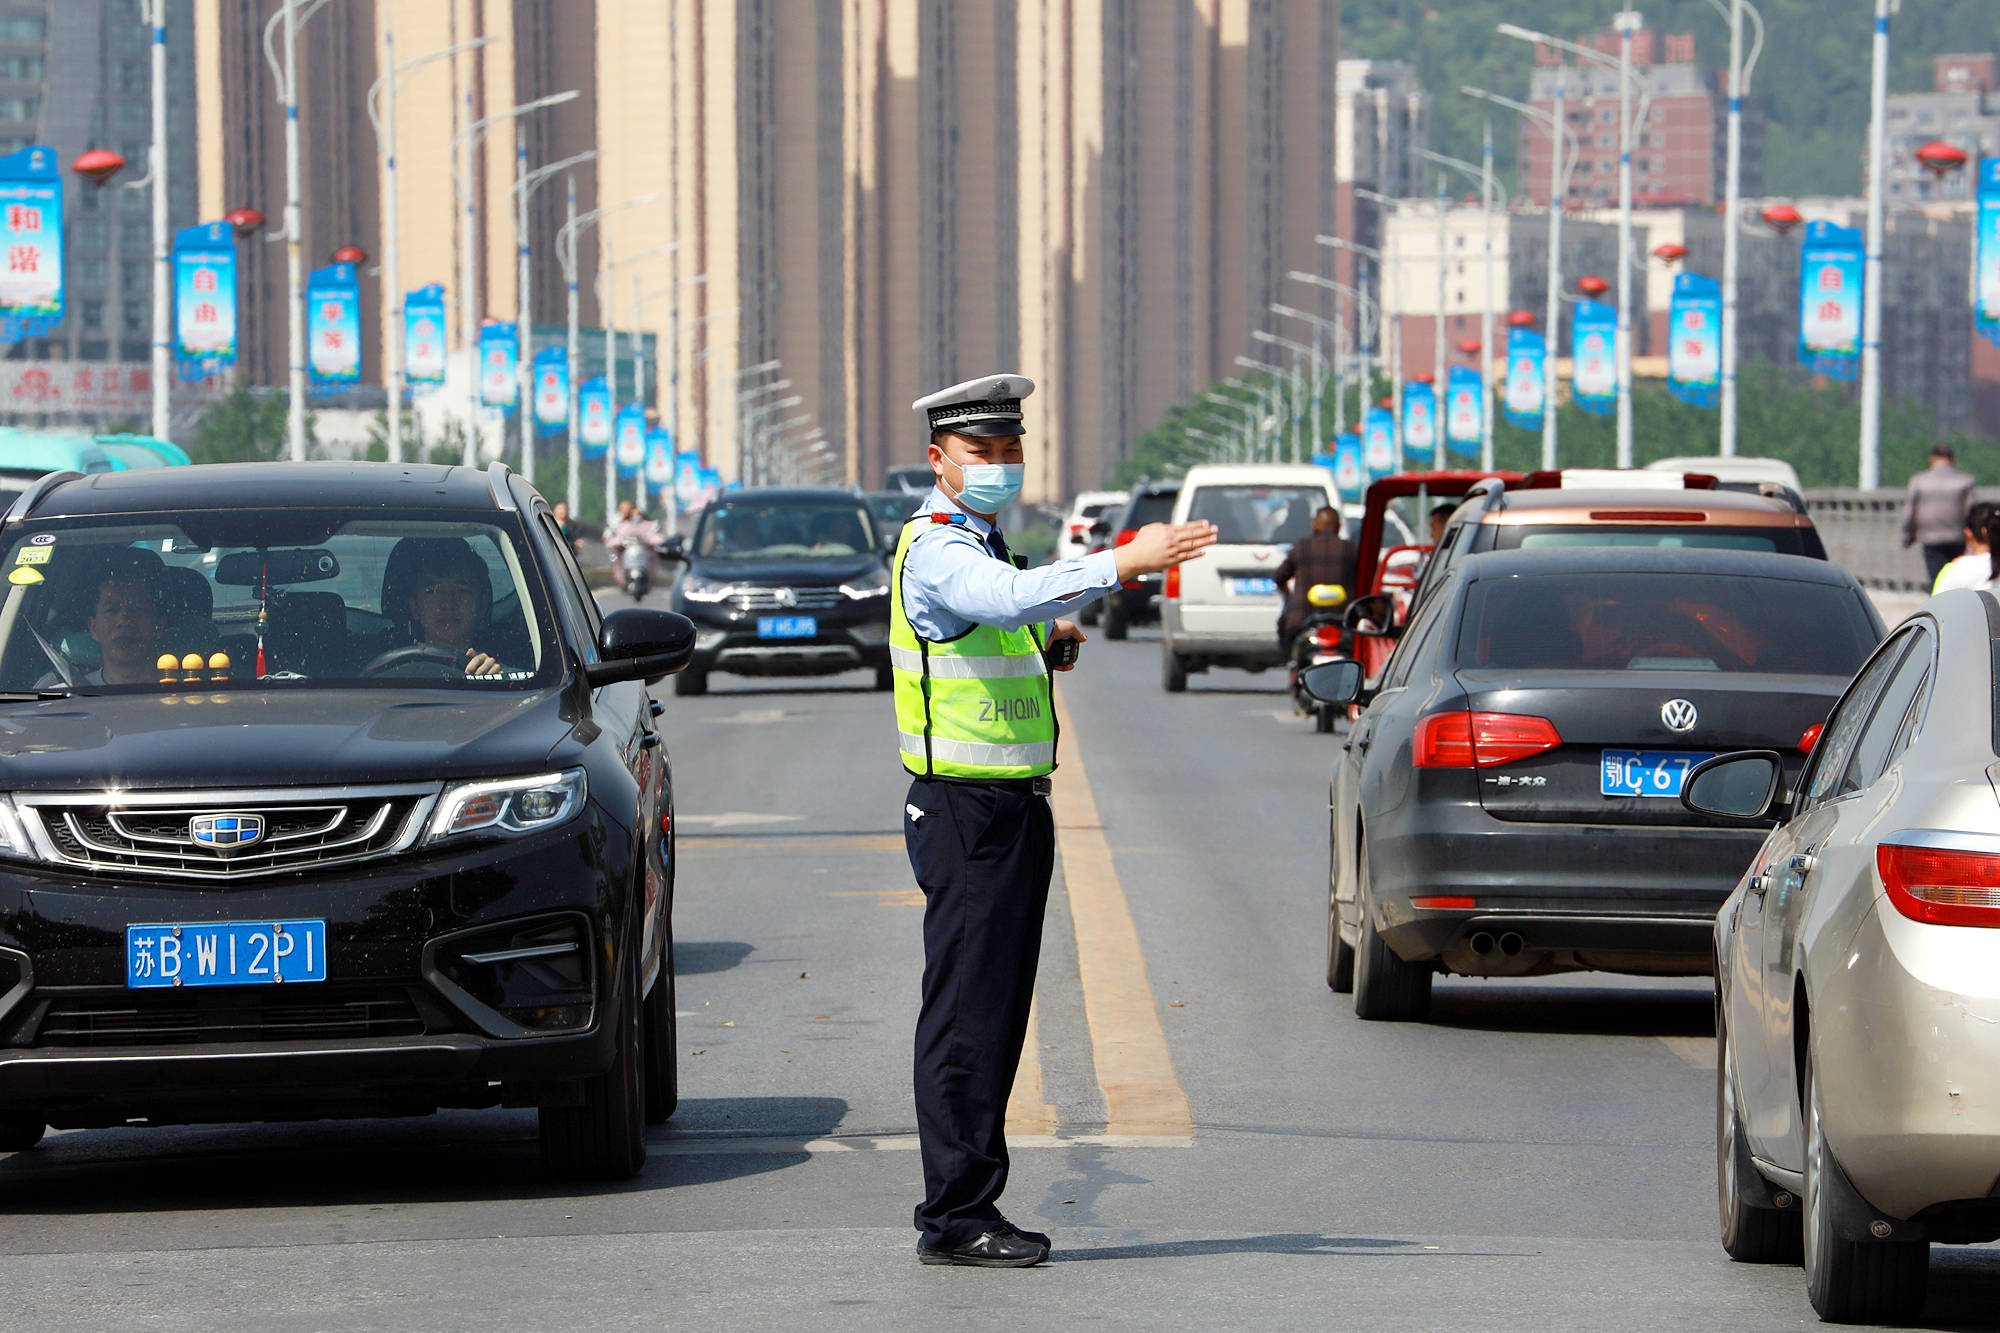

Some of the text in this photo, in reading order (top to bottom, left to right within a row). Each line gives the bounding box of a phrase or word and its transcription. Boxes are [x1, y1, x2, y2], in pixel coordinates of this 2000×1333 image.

[6, 204, 42, 273] 和谐
[193, 267, 217, 323] 自由
[1818, 264, 1843, 322] 自由
[979, 696, 1040, 722] ZHIQIN
[133, 930, 313, 978] 苏B·W12P1
